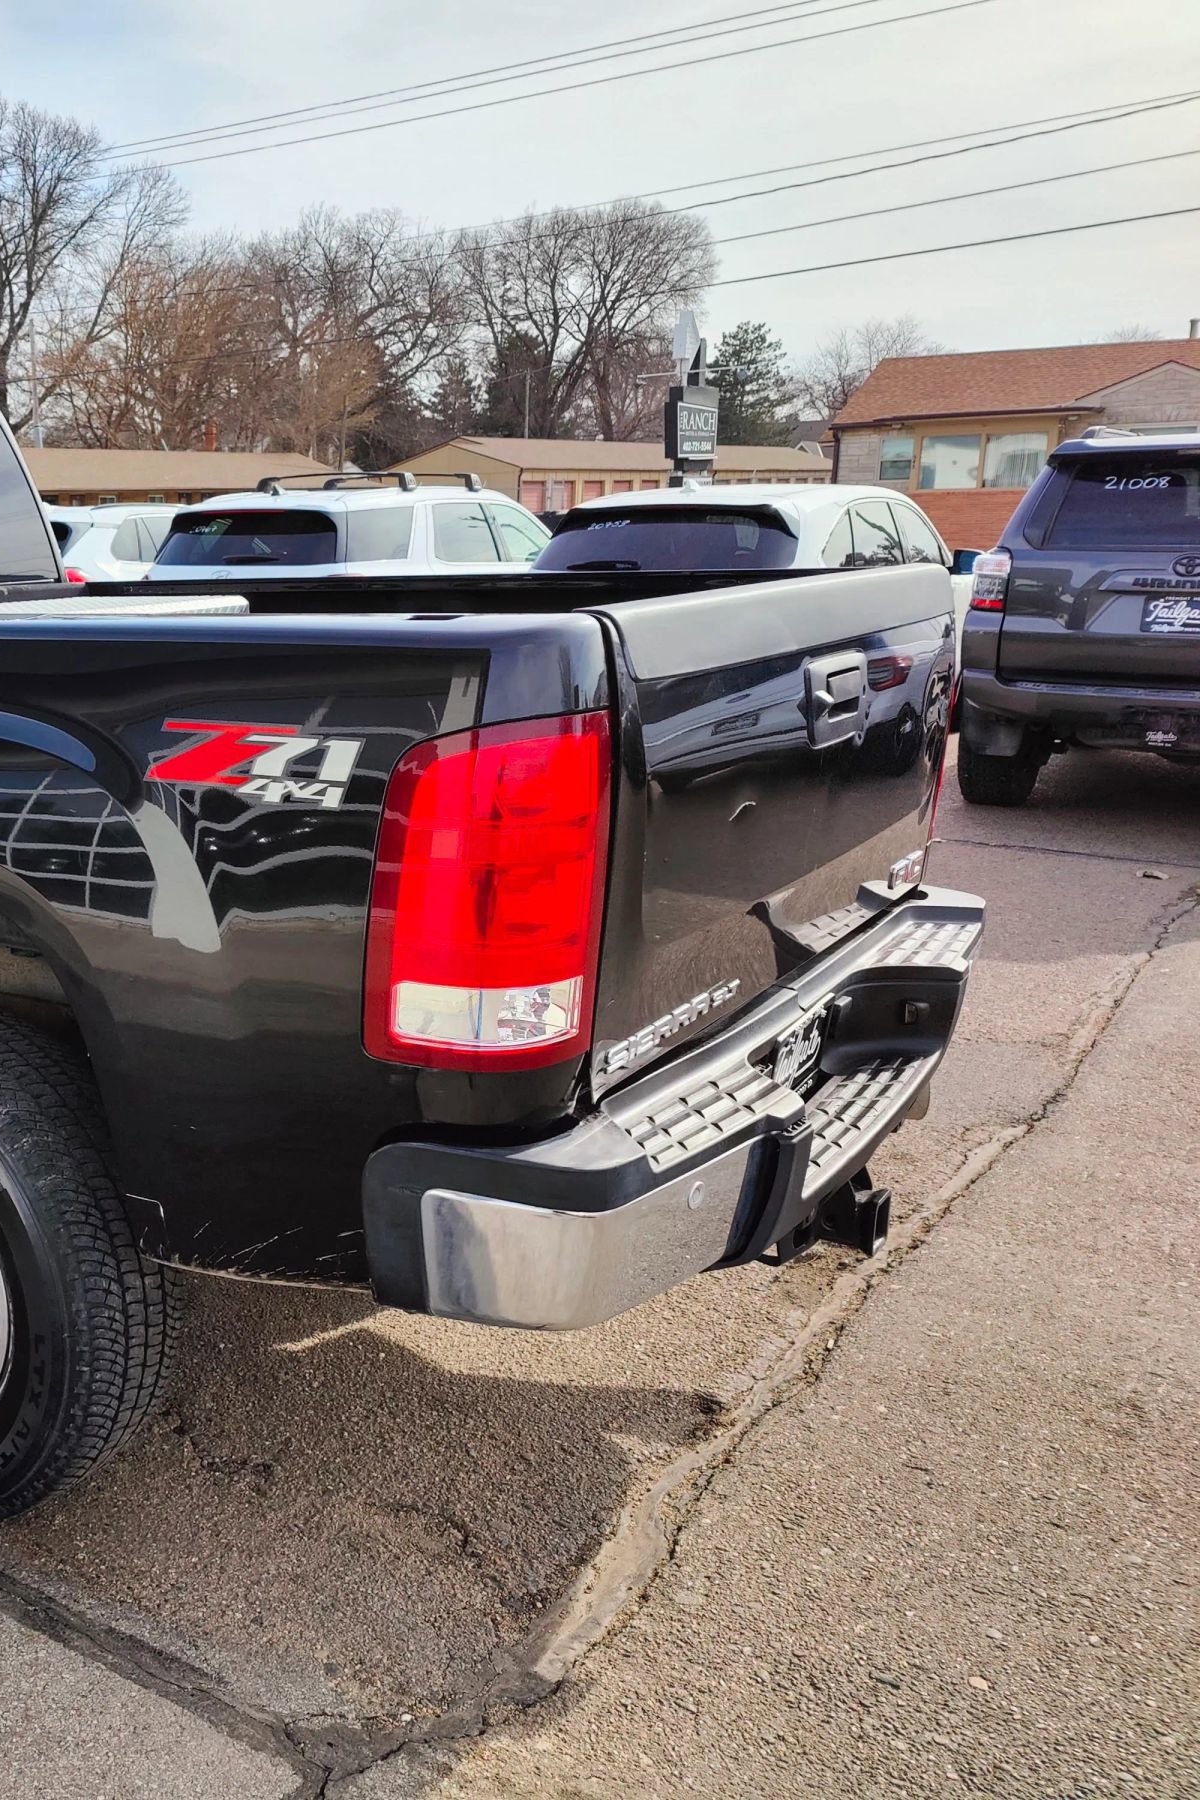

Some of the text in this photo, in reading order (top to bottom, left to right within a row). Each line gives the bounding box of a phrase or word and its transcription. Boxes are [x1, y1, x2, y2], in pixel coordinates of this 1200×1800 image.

[682, 411, 716, 431] RANCH
[1104, 476, 1172, 491] 21008
[1132, 577, 1200, 589] 4RUN
[148, 721, 362, 787] Z71
[604, 992, 710, 1074] SIERRA
